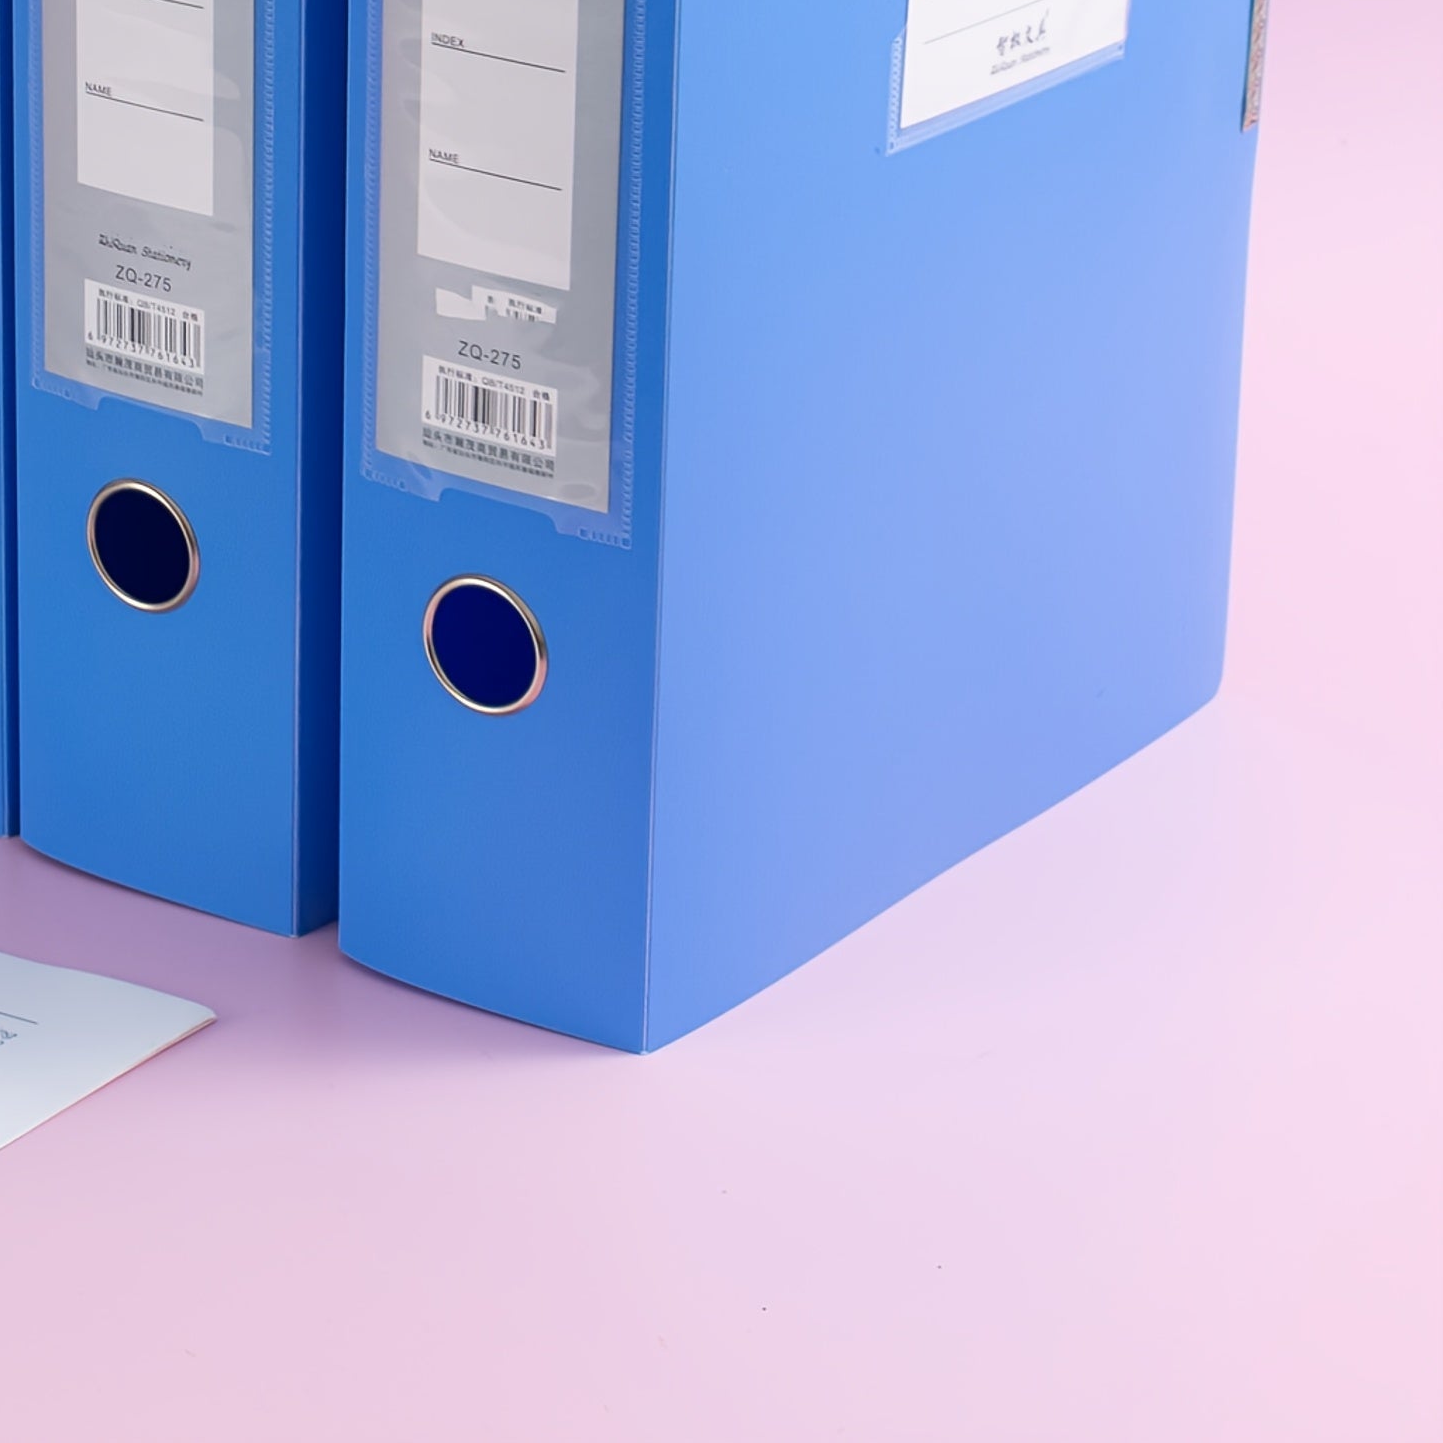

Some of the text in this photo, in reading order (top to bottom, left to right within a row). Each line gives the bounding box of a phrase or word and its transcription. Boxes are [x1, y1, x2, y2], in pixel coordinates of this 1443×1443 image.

[431, 32, 465, 47] INDEX
[429, 148, 459, 163] NAME
[115, 264, 172, 292] ZQ-275
[458, 340, 522, 370] ZQ-275
